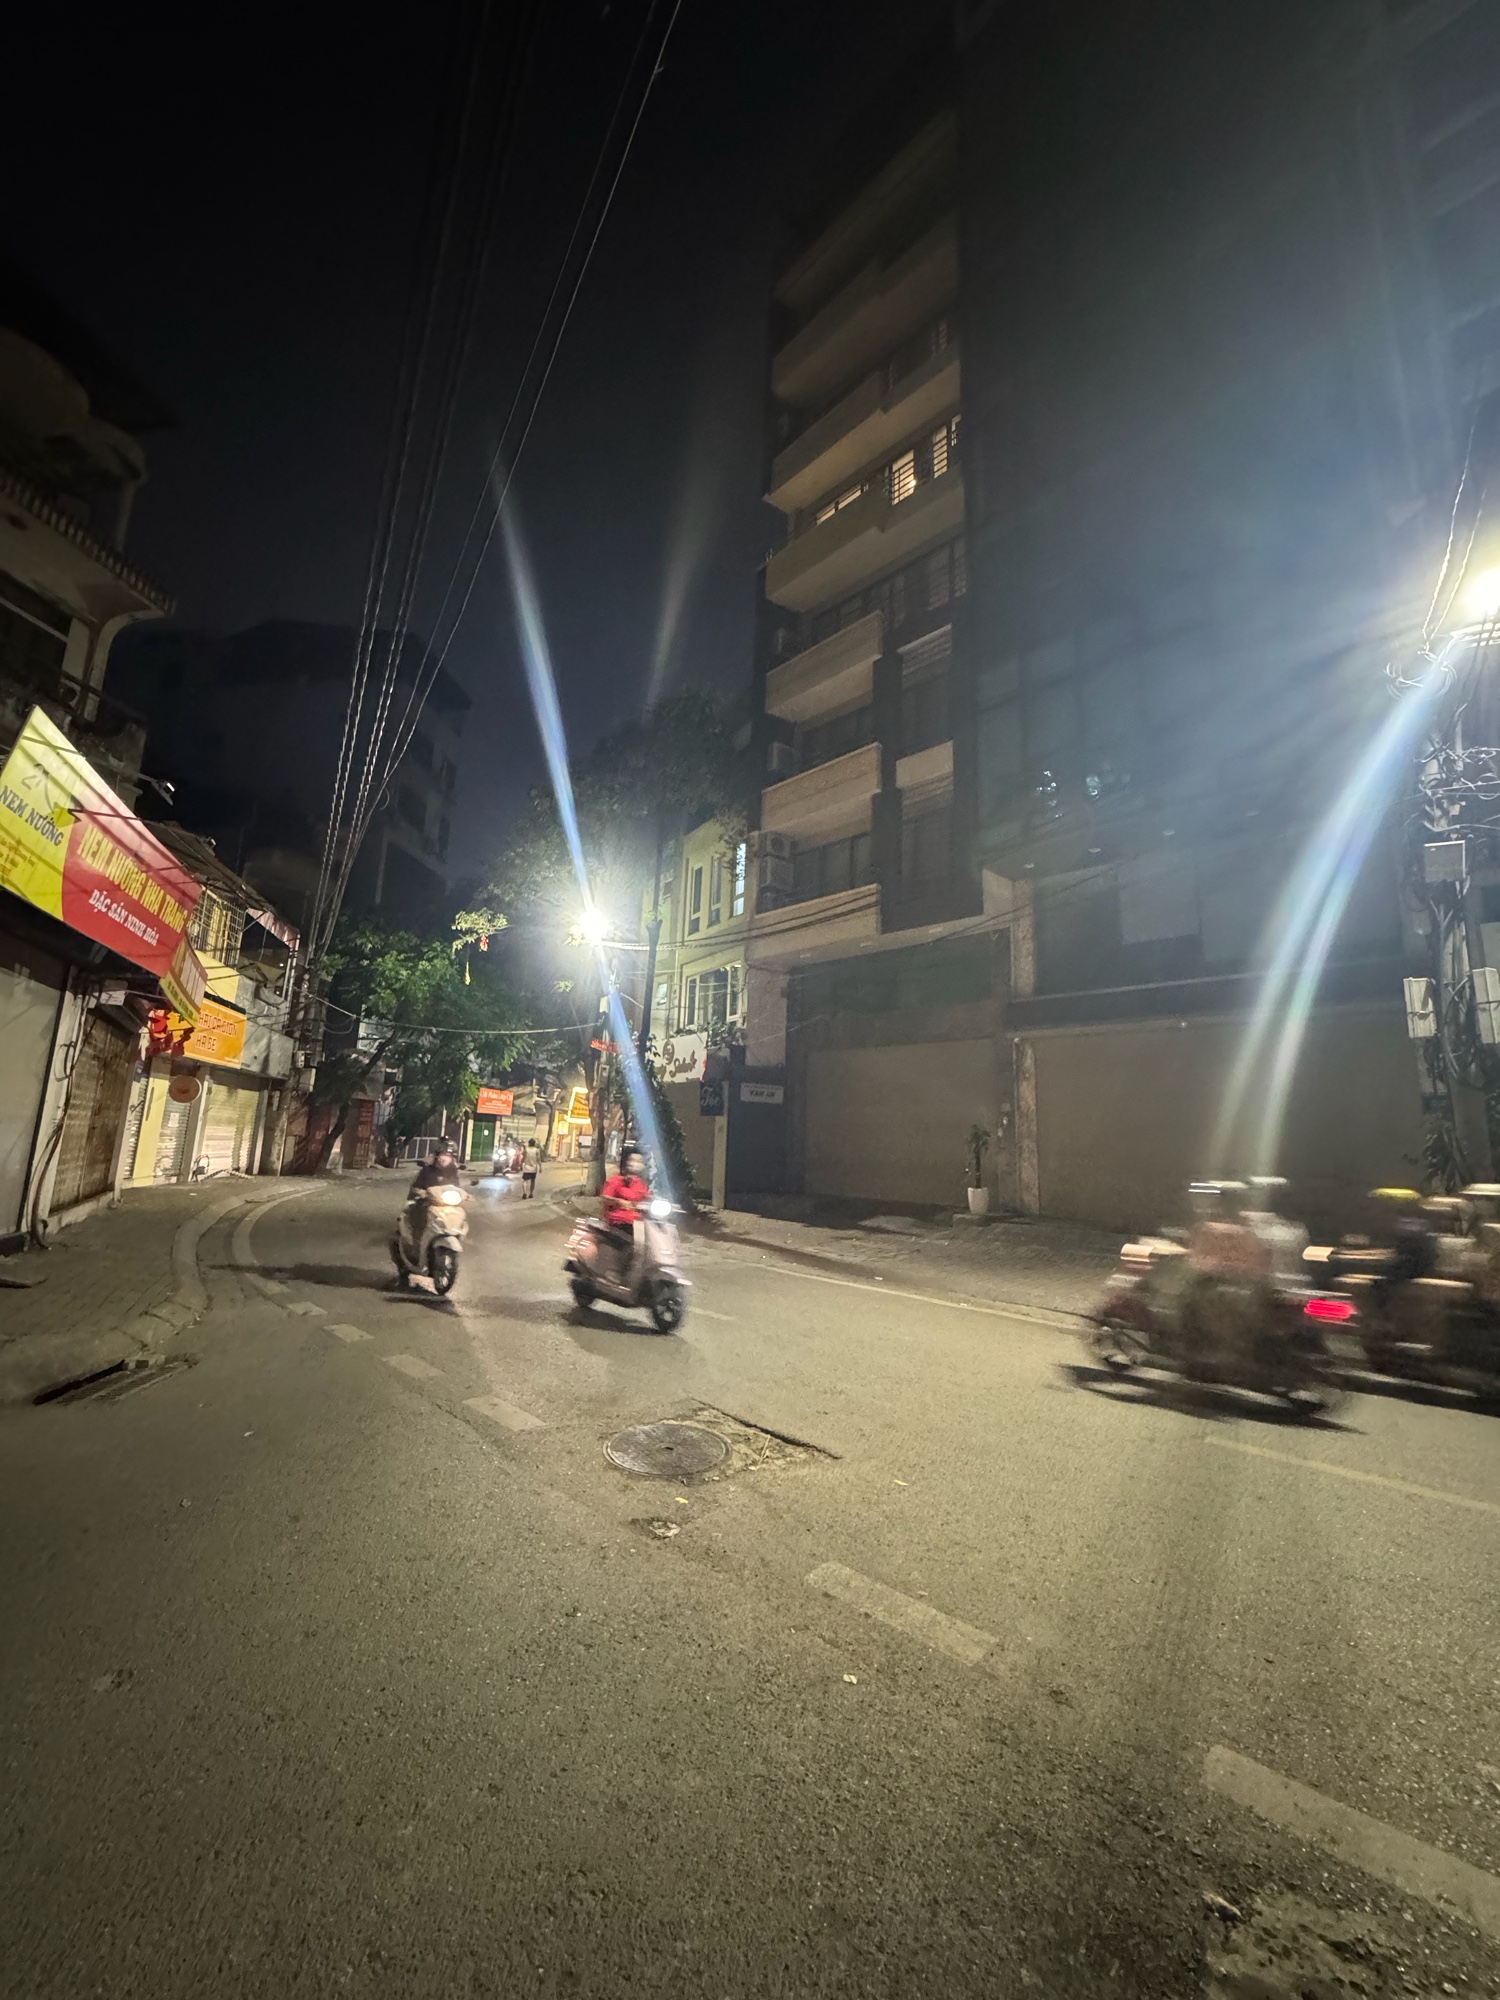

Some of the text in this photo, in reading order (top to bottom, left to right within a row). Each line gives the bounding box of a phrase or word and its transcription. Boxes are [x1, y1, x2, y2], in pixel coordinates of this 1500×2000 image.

[0, 785, 64, 846] NEM NƯỚNG
[77, 822, 114, 873] NEM
[140, 878, 165, 916] NHA
[159, 893, 188, 934] TRANG
